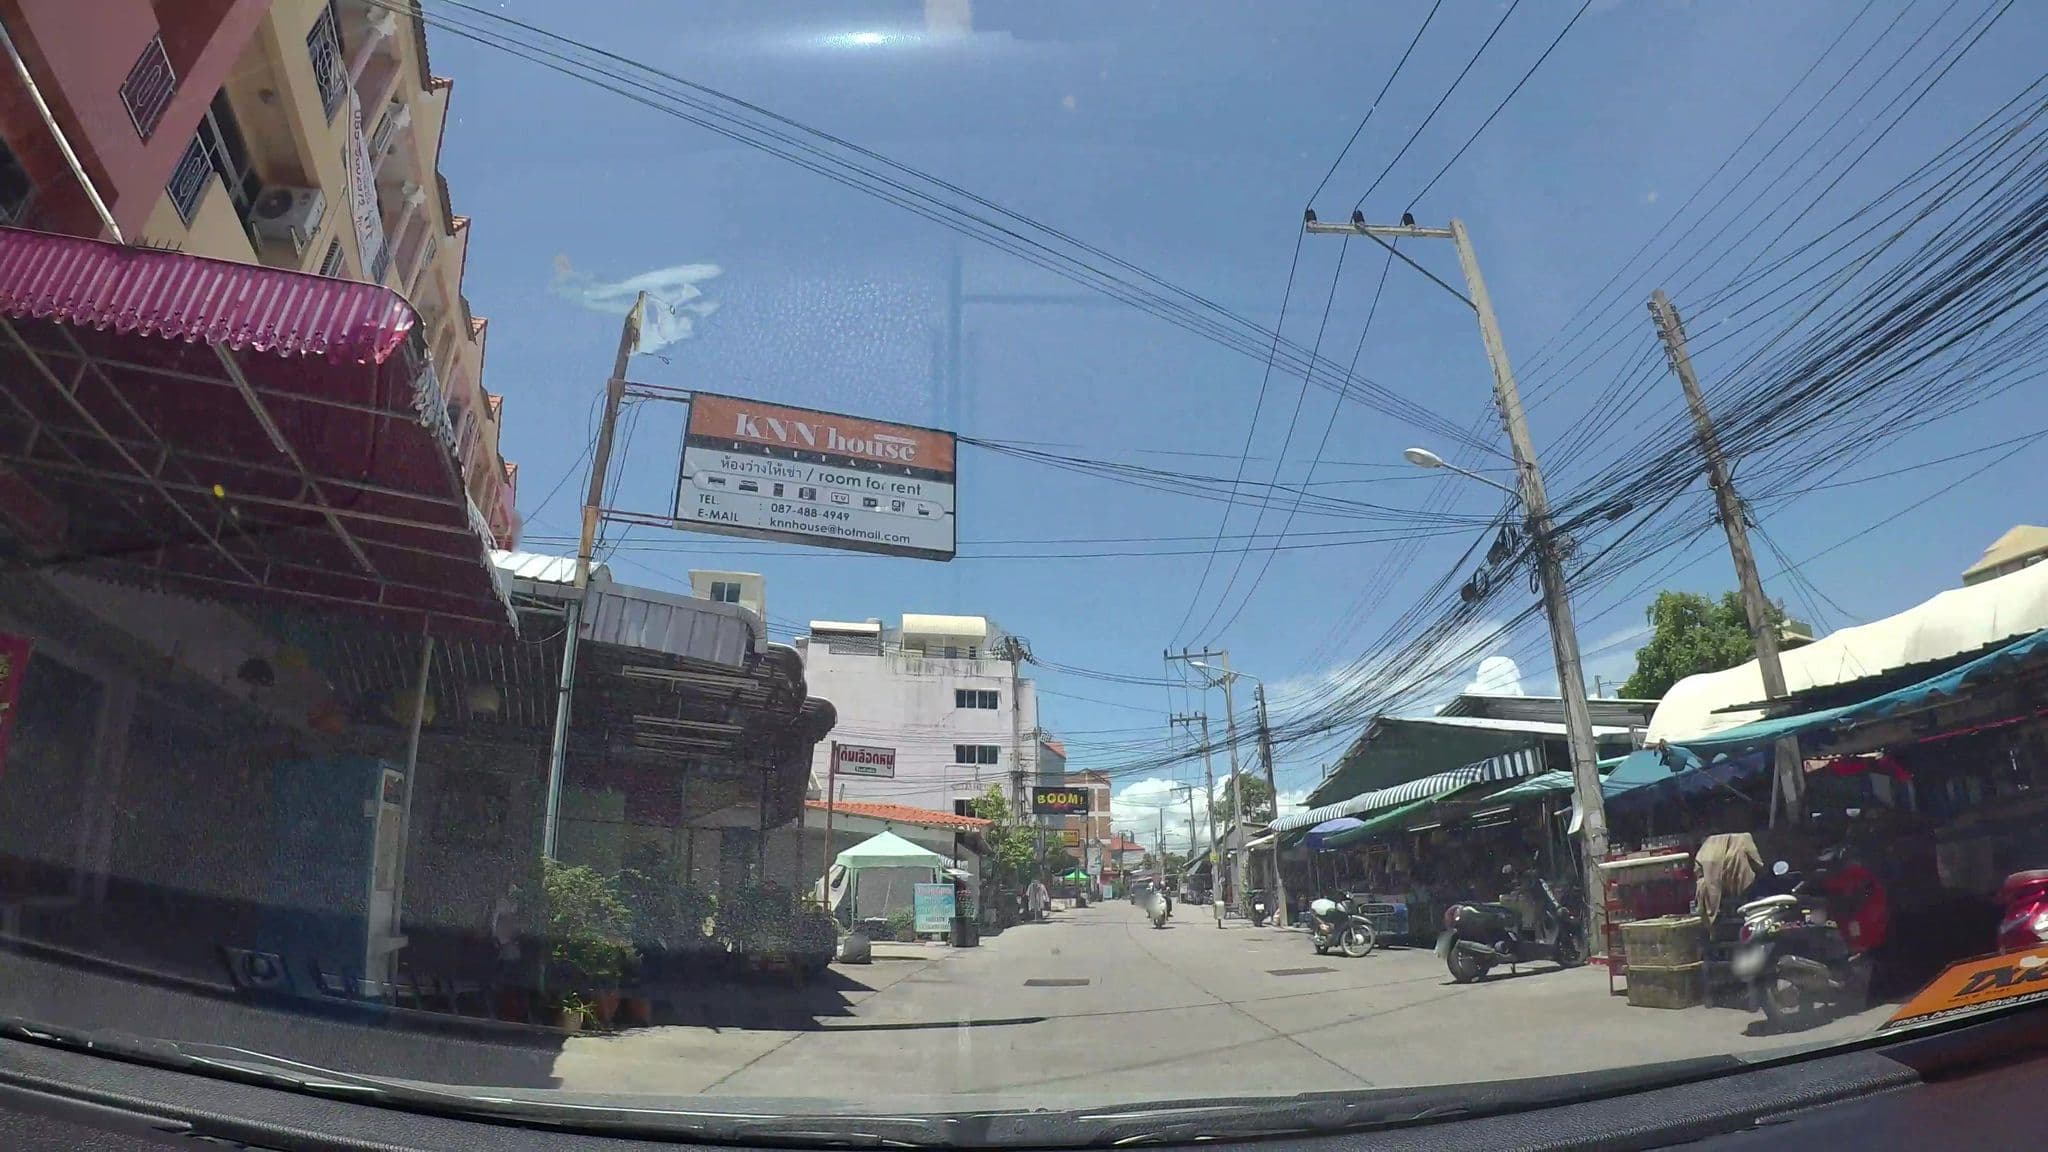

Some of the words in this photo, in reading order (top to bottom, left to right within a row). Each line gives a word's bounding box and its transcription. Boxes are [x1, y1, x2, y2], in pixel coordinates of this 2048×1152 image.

[735, 413, 822, 447] KNN
[827, 426, 916, 461] house
[819, 473, 861, 487] room
[866, 477, 885, 490] for
[891, 483, 921, 495] rent
[697, 508, 739, 522] E-MAIL
[770, 517, 910, 543] knnhouse@hotmail.com
[771, 503, 850, 520] 087-488-4949
